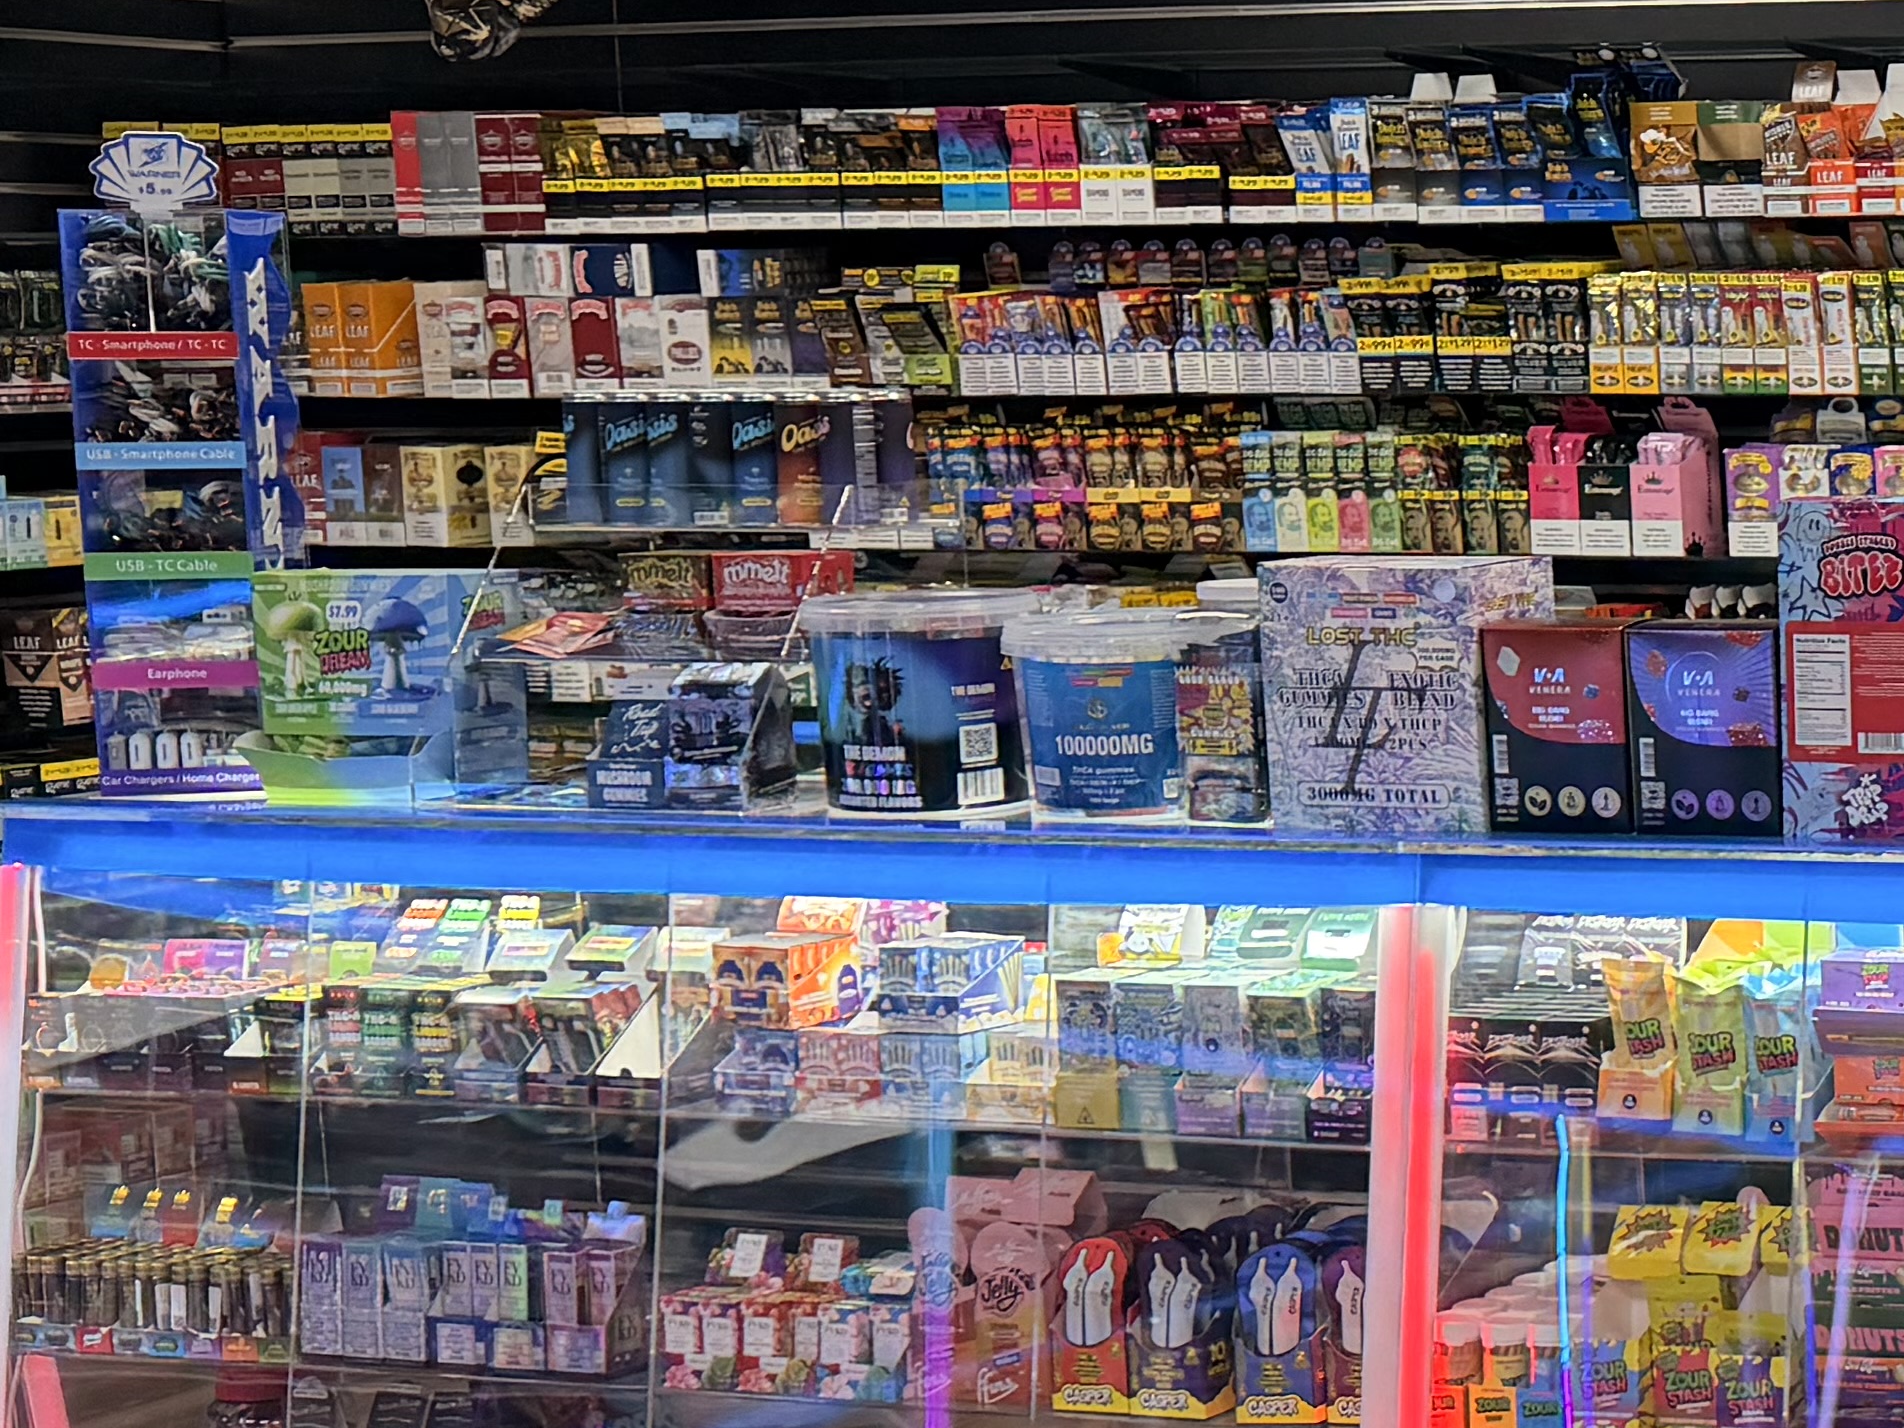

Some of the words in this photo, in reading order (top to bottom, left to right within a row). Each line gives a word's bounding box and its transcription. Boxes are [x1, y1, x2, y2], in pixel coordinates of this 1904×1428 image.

[1765, 152, 1796, 169] LEAF
[1816, 169, 1844, 182] LEAF
[87, 450, 111, 459] USB
[121, 449, 197, 461] Smartphone
[200, 449, 235, 459] Cable
[116, 561, 143, 572] USB
[157, 561, 174, 571] TC
[177, 561, 217, 572] Cable
[328, 605, 357, 617] $7.99
[315, 630, 369, 654] ZOUR
[1306, 626, 1362, 646] LOST
[1371, 626, 1417, 646] THC
[320, 652, 370, 672] DREAM
[148, 669, 207, 682] Earphone
[102, 776, 121, 786] Car
[124, 775, 174, 786] Chargers
[183, 774, 214, 783] Home
[1379, 787, 1441, 804] TOTAL
[1665, 1371, 1711, 1389] ZOUR
[1062, 1386, 1113, 1408] CASPER
[1726, 1380, 1772, 1399] ZOUR
[1139, 1390, 1190, 1412] CASPER
[1248, 1397, 1299, 1417] CASPER
[1667, 1389, 1712, 1408] STASH
[1728, 1398, 1774, 1415] STASH
